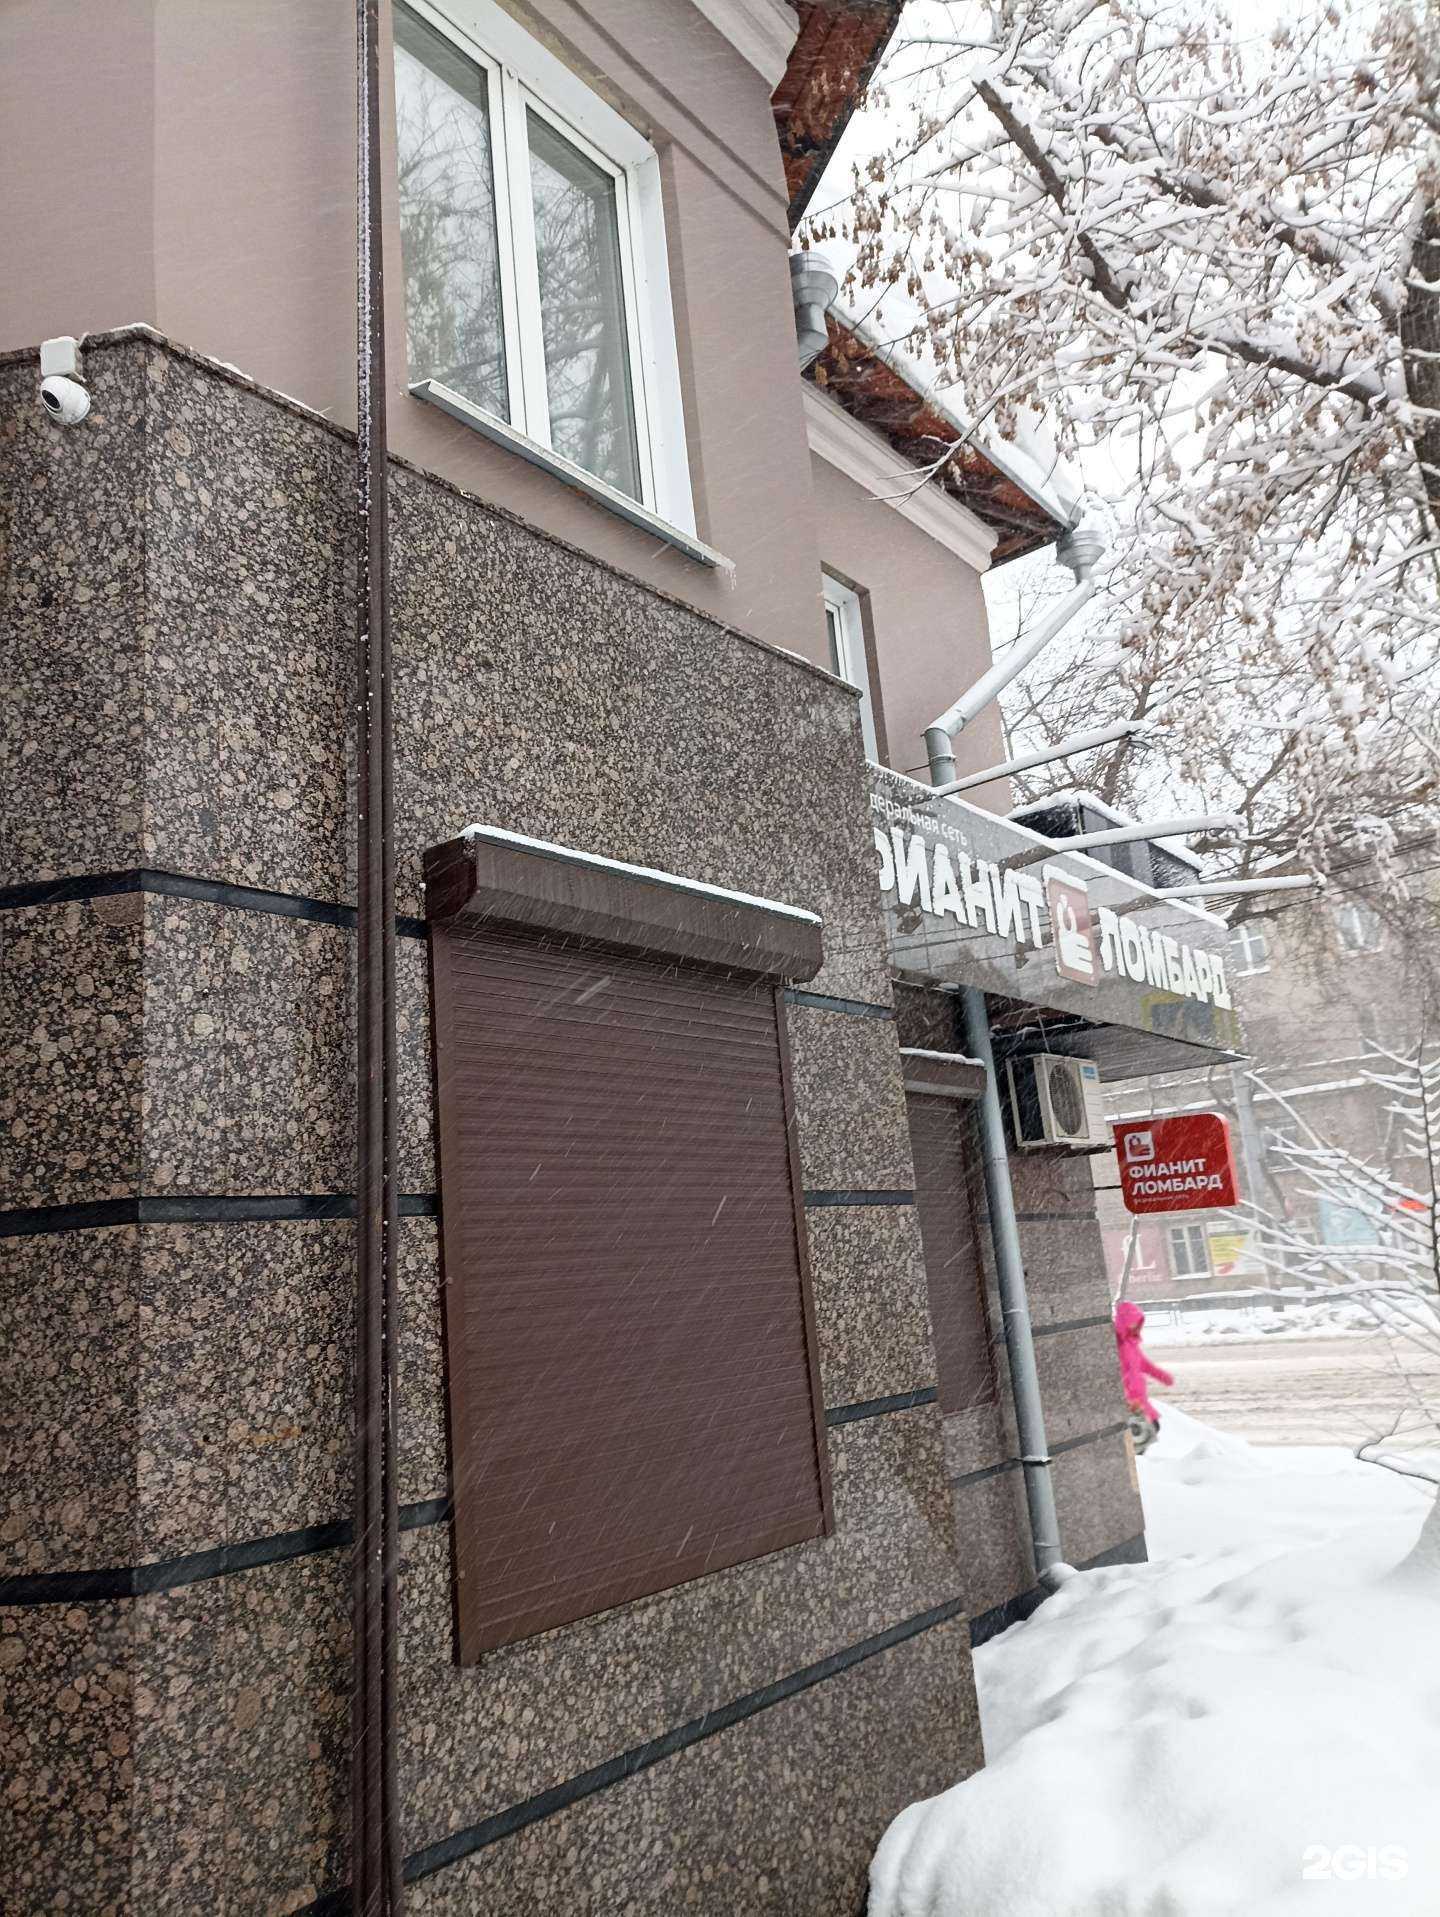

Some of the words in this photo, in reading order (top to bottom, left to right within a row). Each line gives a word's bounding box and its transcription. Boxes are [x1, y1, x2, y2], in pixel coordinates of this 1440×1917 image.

[941, 822, 968, 847] сеть
[1097, 906, 1232, 1011] ЛОМБАРД
[1129, 1158, 1207, 1179] ФИАНИТ
[1131, 1174, 1224, 1196] ЛОМБАРД
